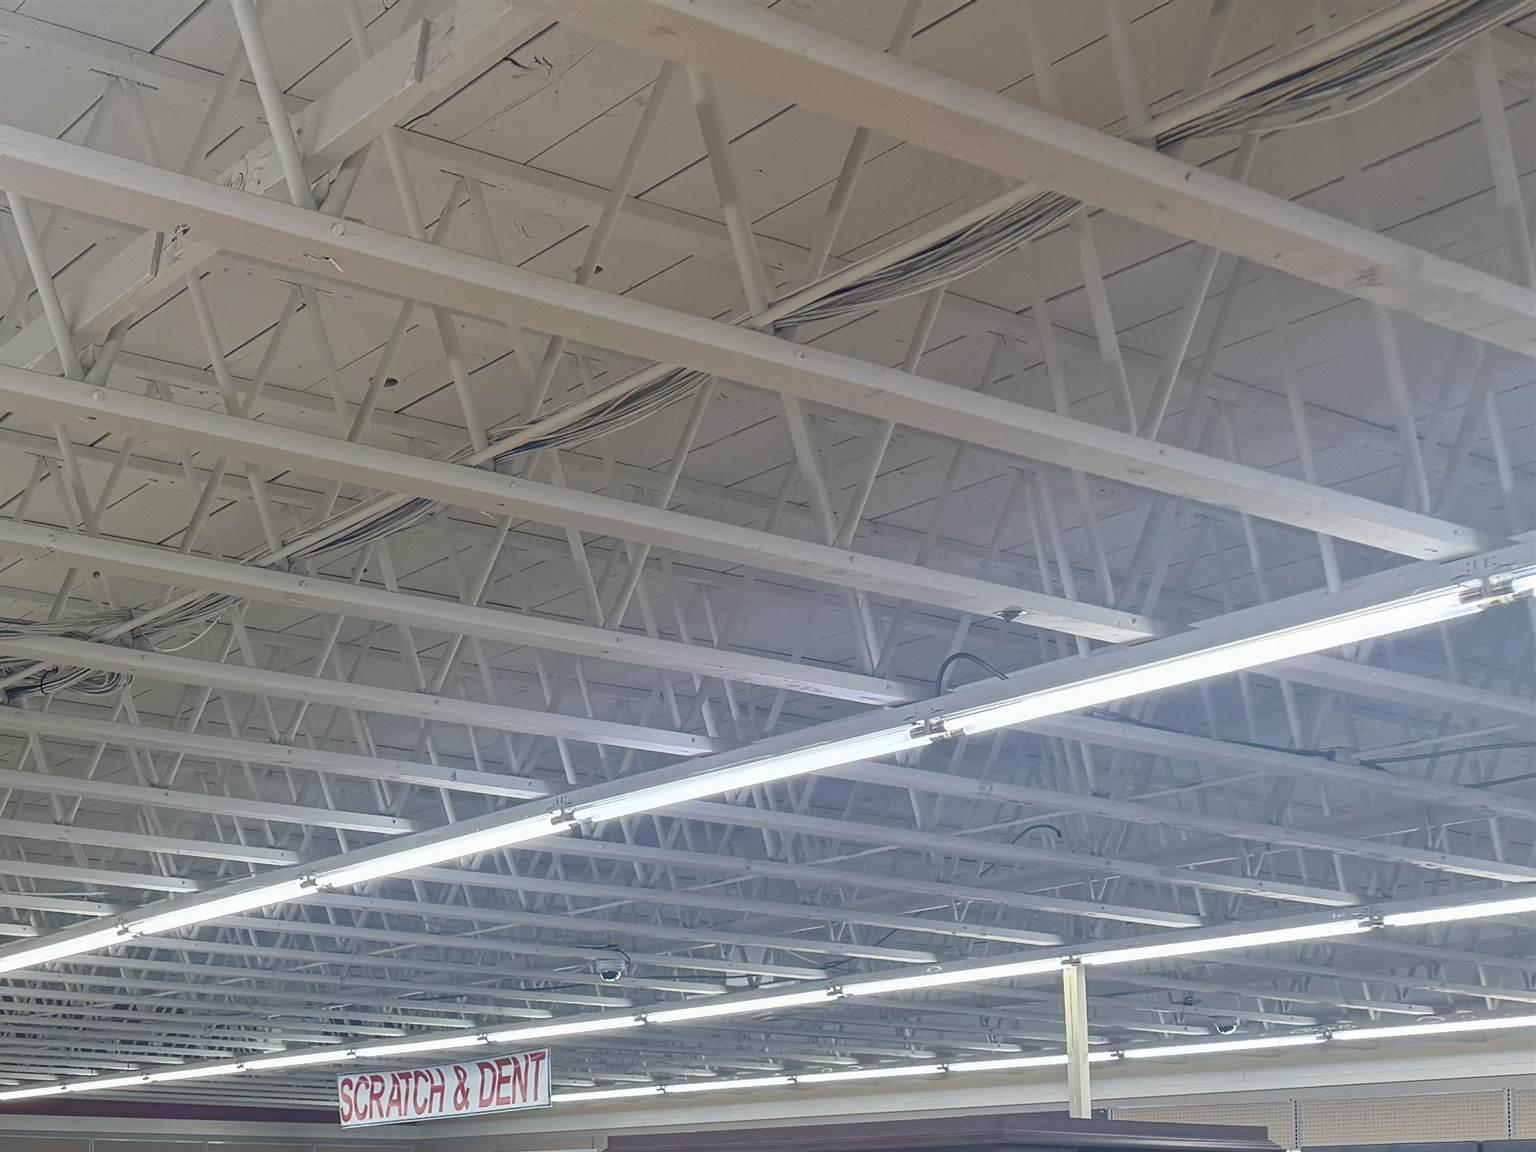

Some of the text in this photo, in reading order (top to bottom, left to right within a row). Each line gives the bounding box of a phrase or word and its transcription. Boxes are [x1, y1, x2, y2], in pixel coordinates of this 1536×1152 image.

[339, 1051, 546, 1122] SCRATCH & DENT
